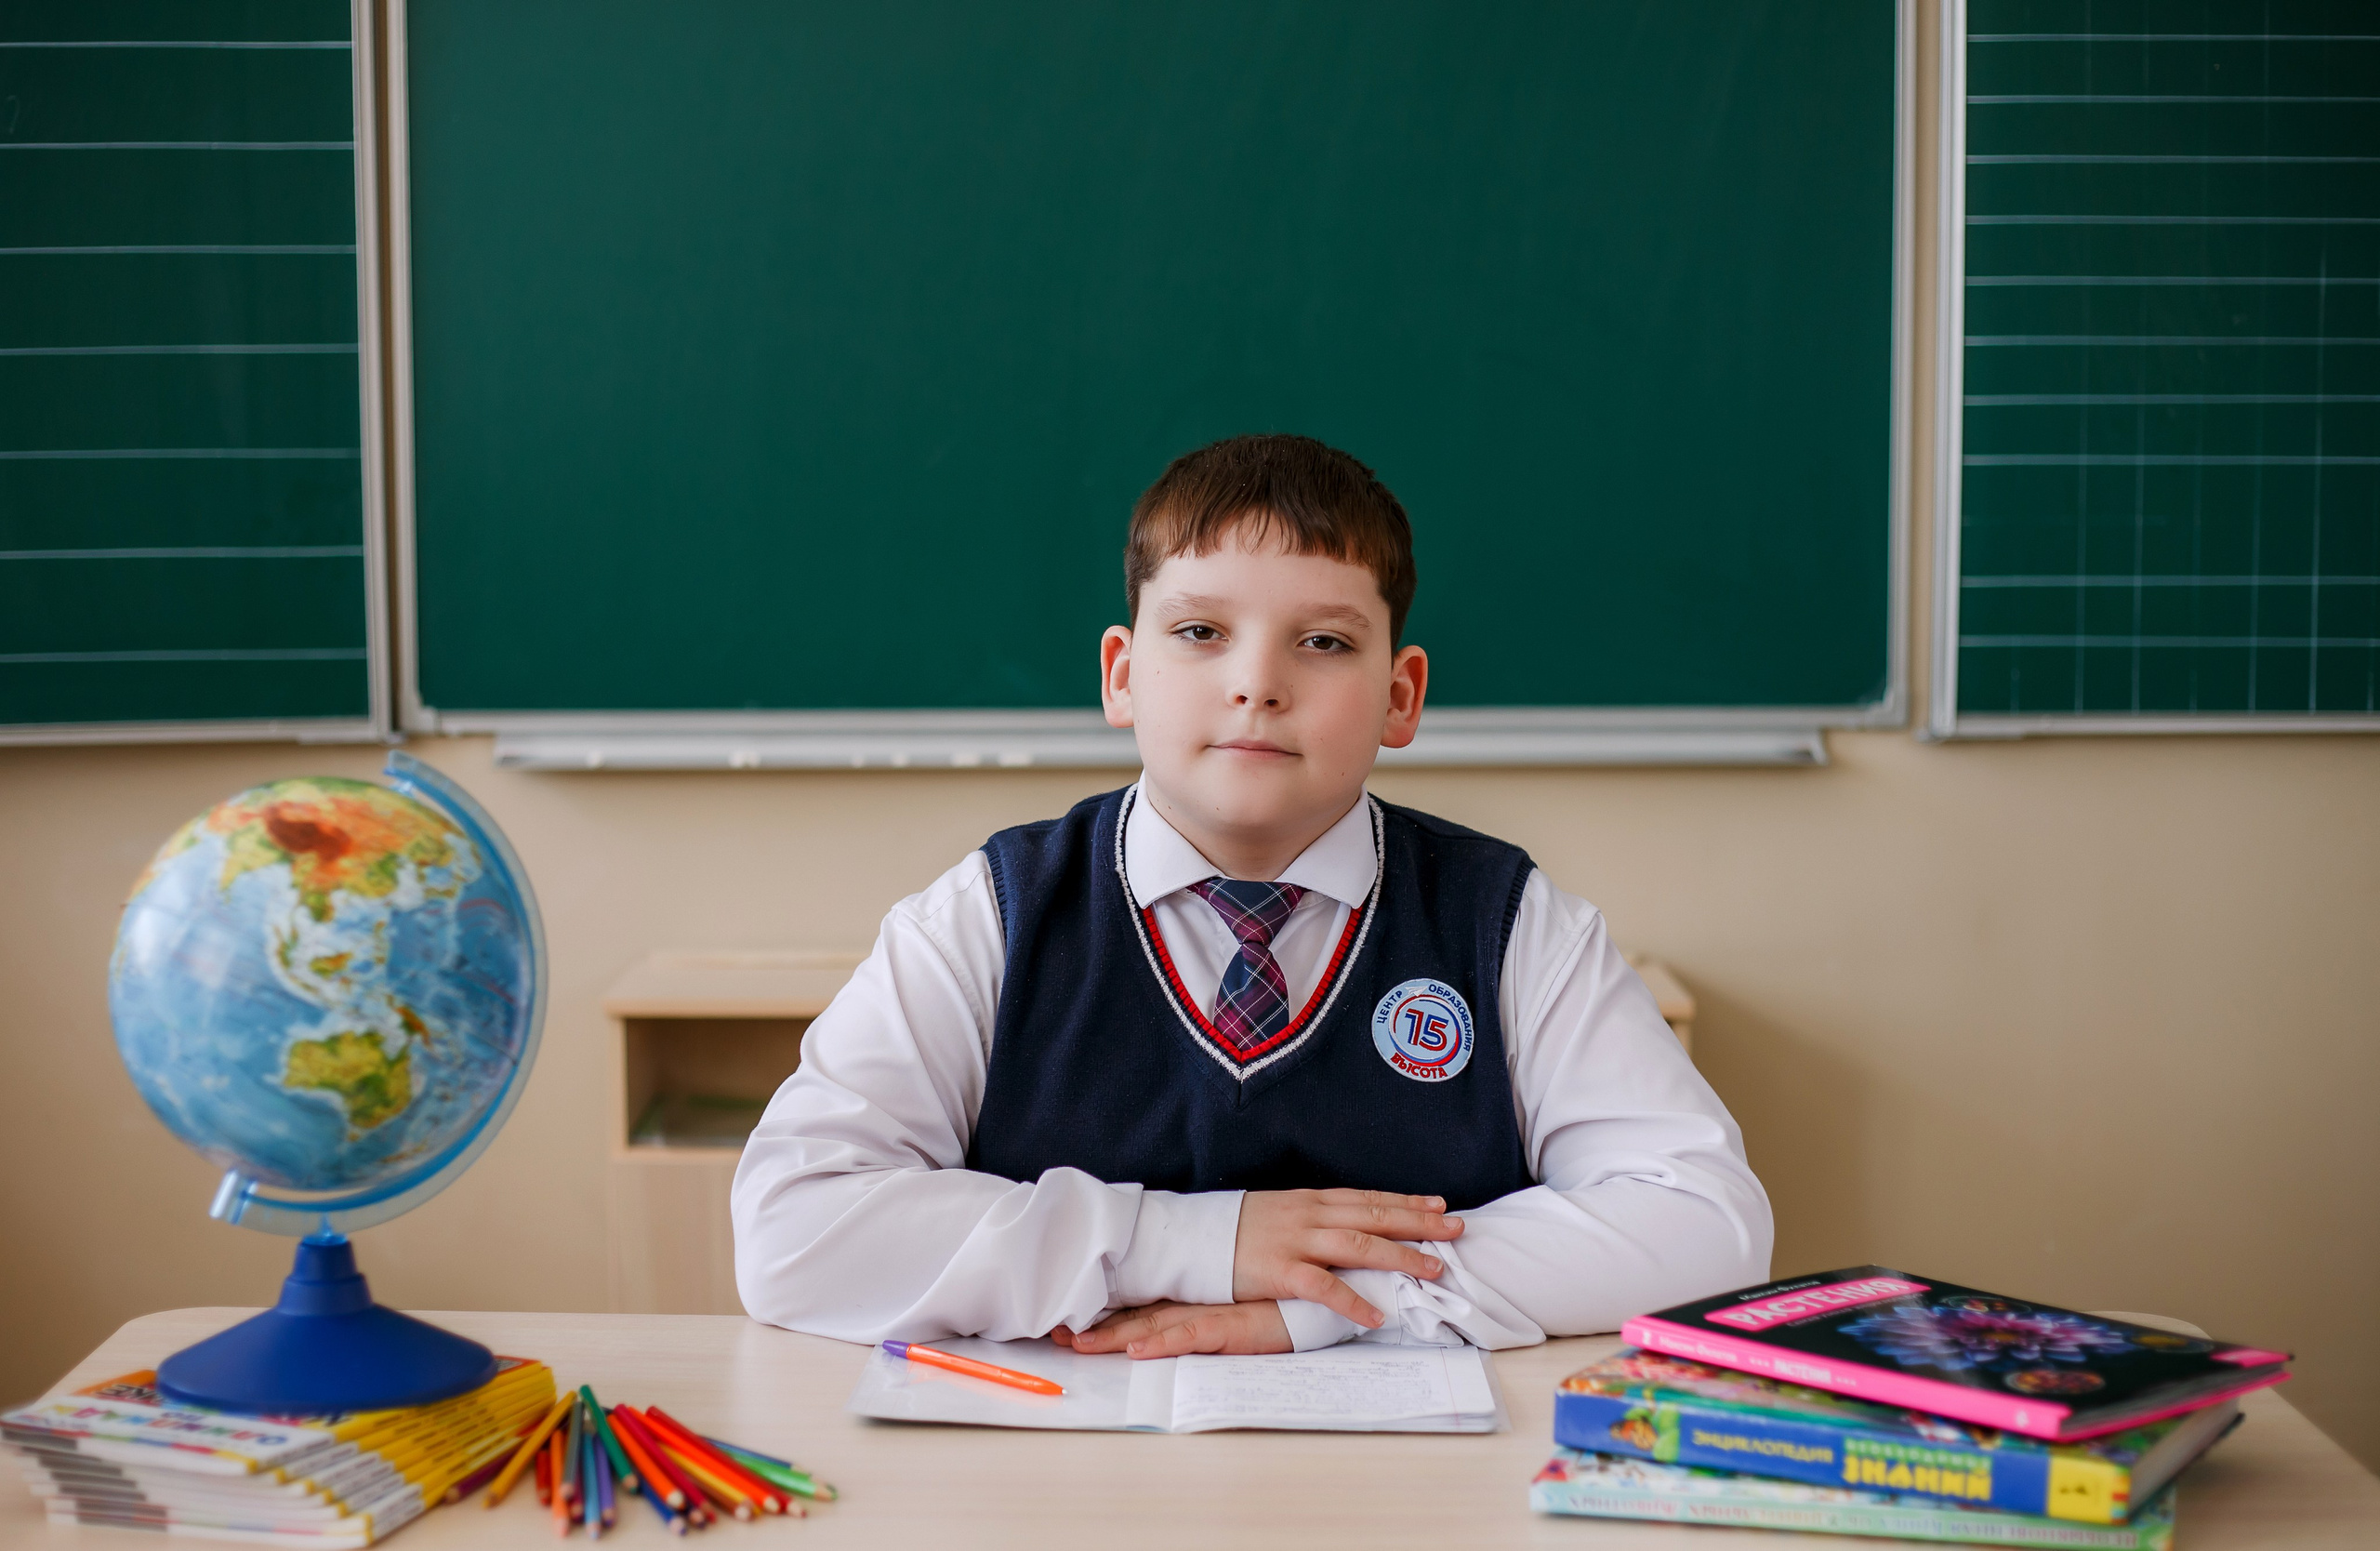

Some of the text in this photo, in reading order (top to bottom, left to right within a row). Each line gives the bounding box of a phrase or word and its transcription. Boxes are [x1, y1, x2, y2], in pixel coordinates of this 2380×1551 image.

[1377, 984, 1472, 1052] ЦЕНТР ОБРАЗОВАНИЯ
[1405, 1008, 1449, 1052] 15
[1390, 1053, 1448, 1079] ВЫСОТА
[1723, 1278, 1910, 1325] РАСТЕНИЯ
[1692, 1429, 1834, 1464] ЭНЦИКЛОПЕДИЯ
[1842, 1455, 1992, 1501] ЗНАНИЙ
